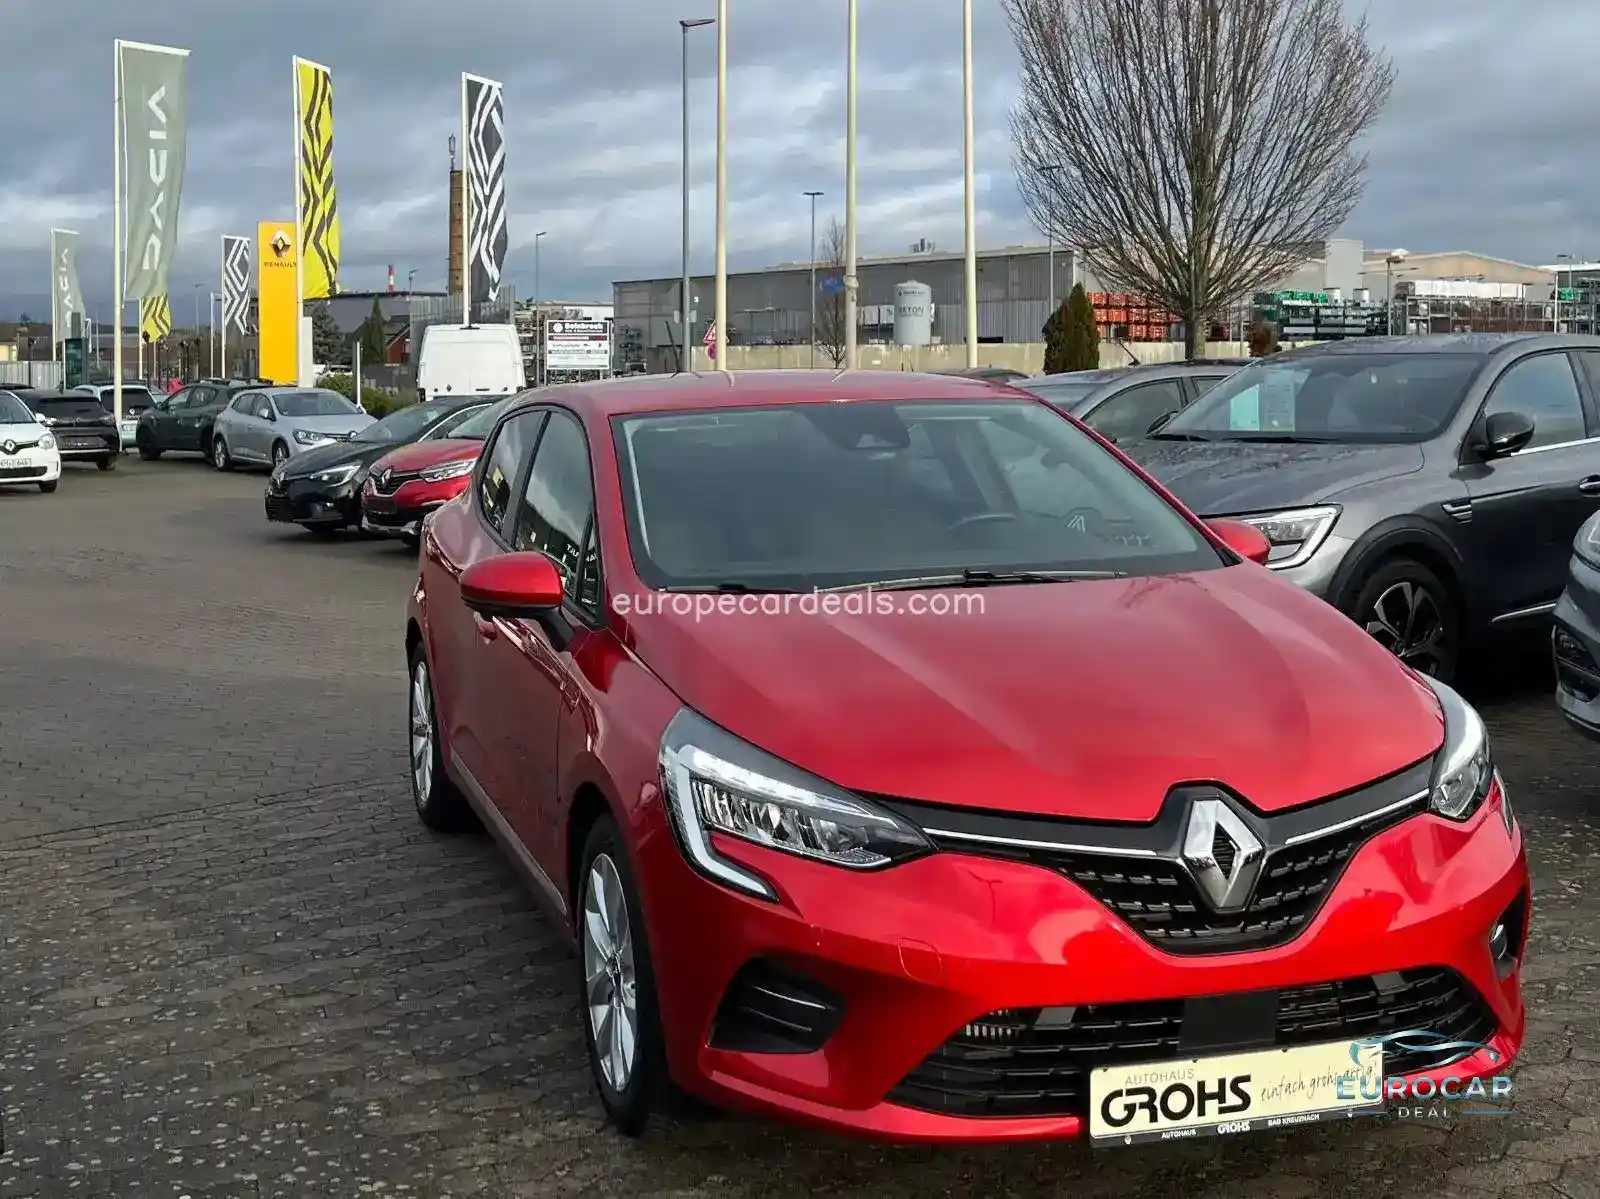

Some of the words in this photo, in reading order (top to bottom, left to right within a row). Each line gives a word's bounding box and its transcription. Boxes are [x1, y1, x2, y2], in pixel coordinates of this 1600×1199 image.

[1125, 1068, 1195, 1086] AUTOHAUS
[1261, 1073, 1306, 1102] einfach
[1101, 1074, 1252, 1128] GROHS
[1161, 1128, 1197, 1139] AUTOHAUS
[1217, 1120, 1251, 1134] GROHS
